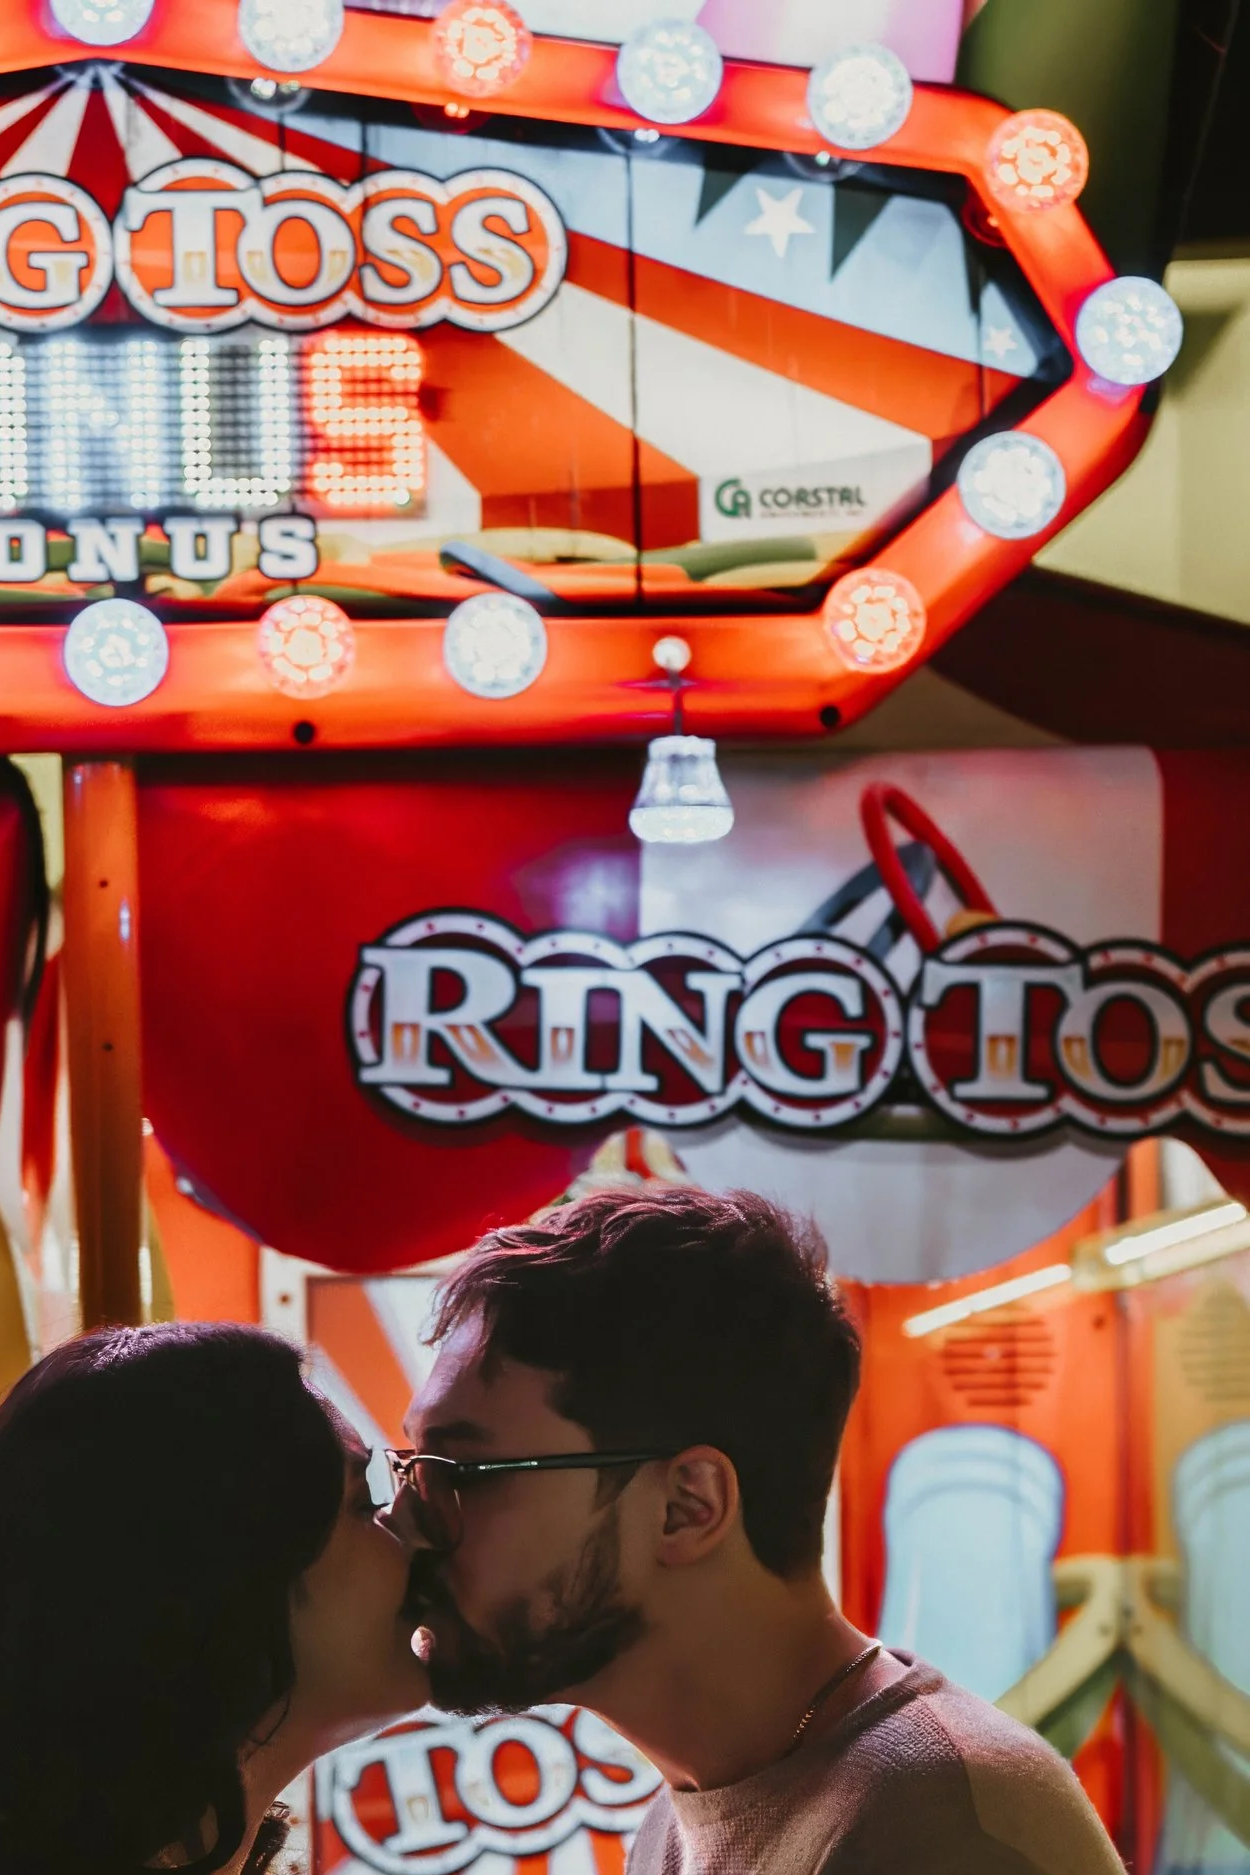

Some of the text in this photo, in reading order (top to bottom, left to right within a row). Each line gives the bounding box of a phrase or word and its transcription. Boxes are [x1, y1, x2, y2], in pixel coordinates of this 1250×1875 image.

[125, 187, 536, 308] TOSS
[359, 946, 1250, 1106] RING TOS
[348, 1706, 668, 1854] TOS
